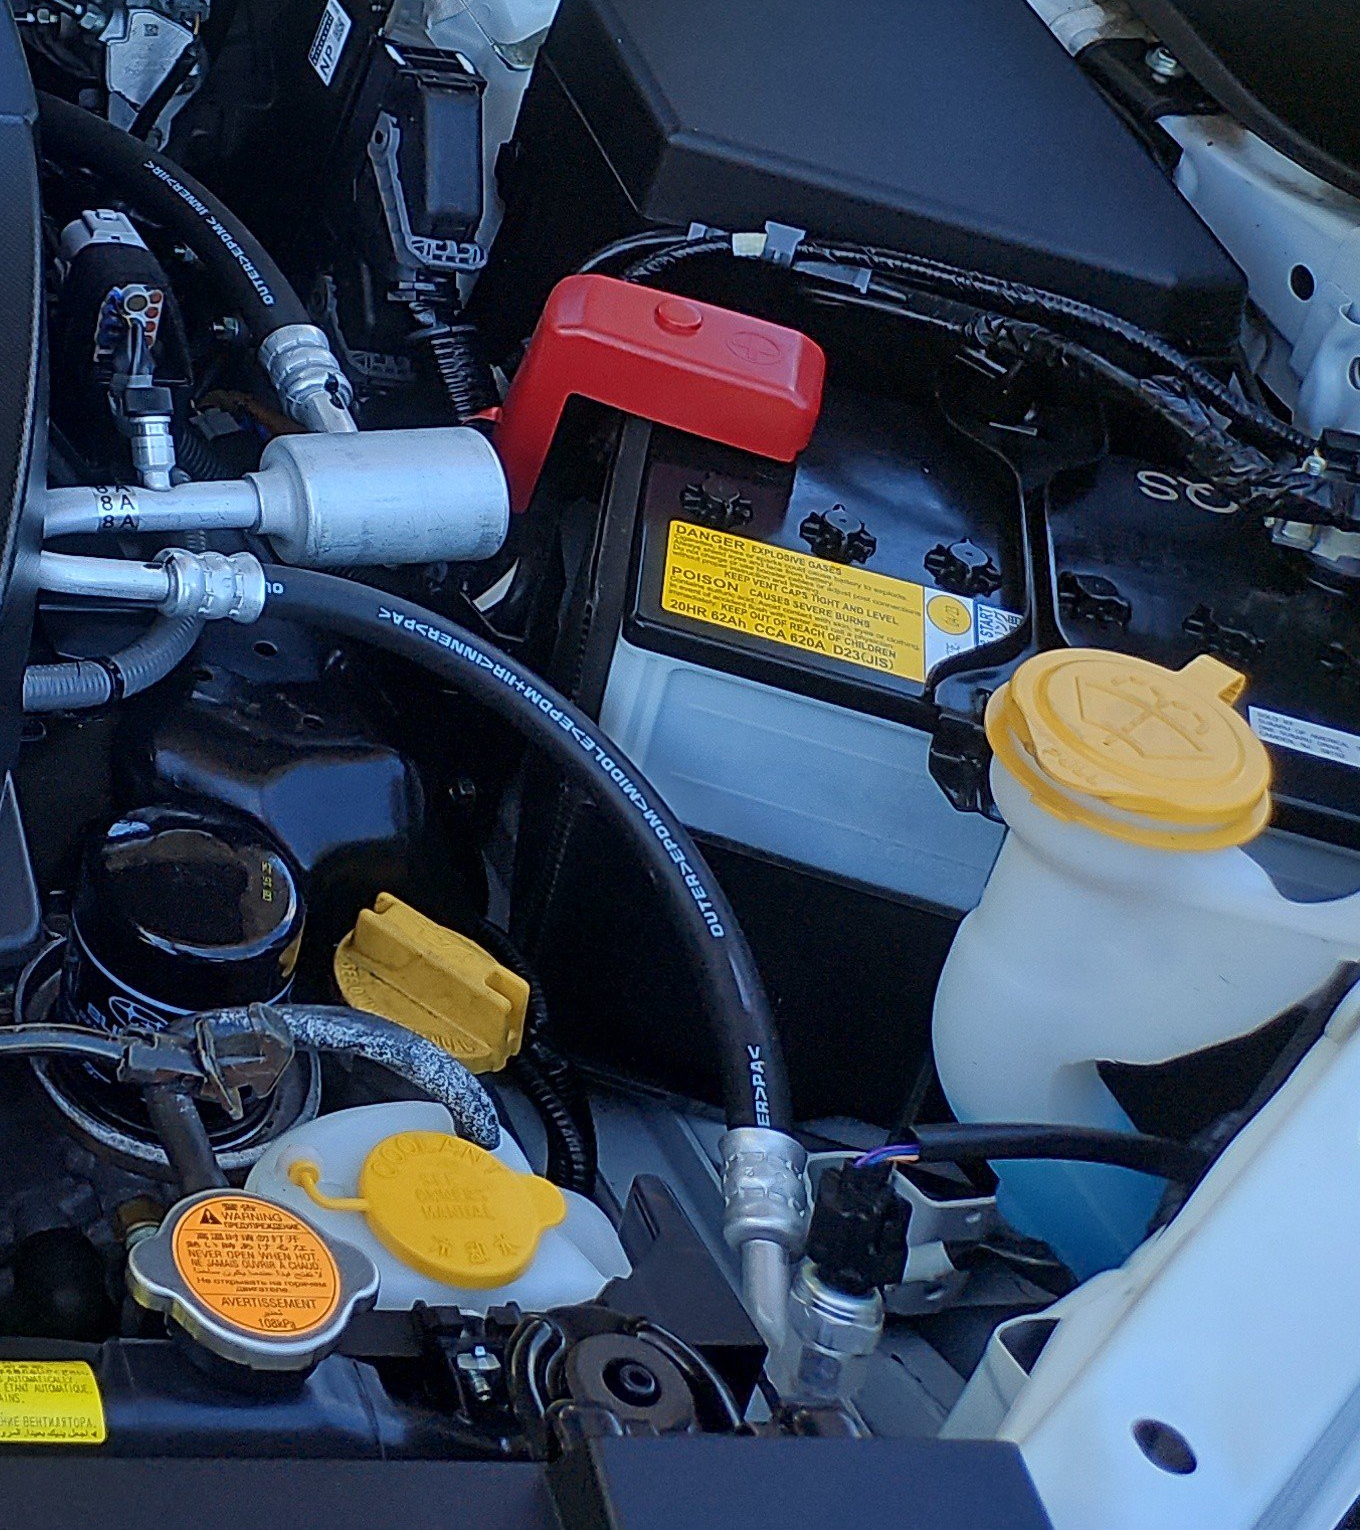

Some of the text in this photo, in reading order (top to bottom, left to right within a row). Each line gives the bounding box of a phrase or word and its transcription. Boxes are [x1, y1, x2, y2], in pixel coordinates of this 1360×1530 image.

[676, 524, 841, 575] DANGER EXPLOSIVE GASES
[671, 565, 870, 628] POISON CAUSES SEVERE BURNS
[724, 570, 899, 625] KEEP VENT CAPS TIGHT AND LEVEL
[670, 598, 893, 670] 20HR 62Ah CCA 620A D23(JIS)
[721, 603, 896, 658] KEEP OUT OF REACH OF CHILDREN
[221, 1212, 283, 1222] WARNING
[188, 1249, 320, 1262] NEVER OPEN WHEN HOT.
[191, 1259, 322, 1271] NE JAMAIS OUVRIR CHAUD.
[221, 1297, 317, 1309] AVERTISSEMENT
